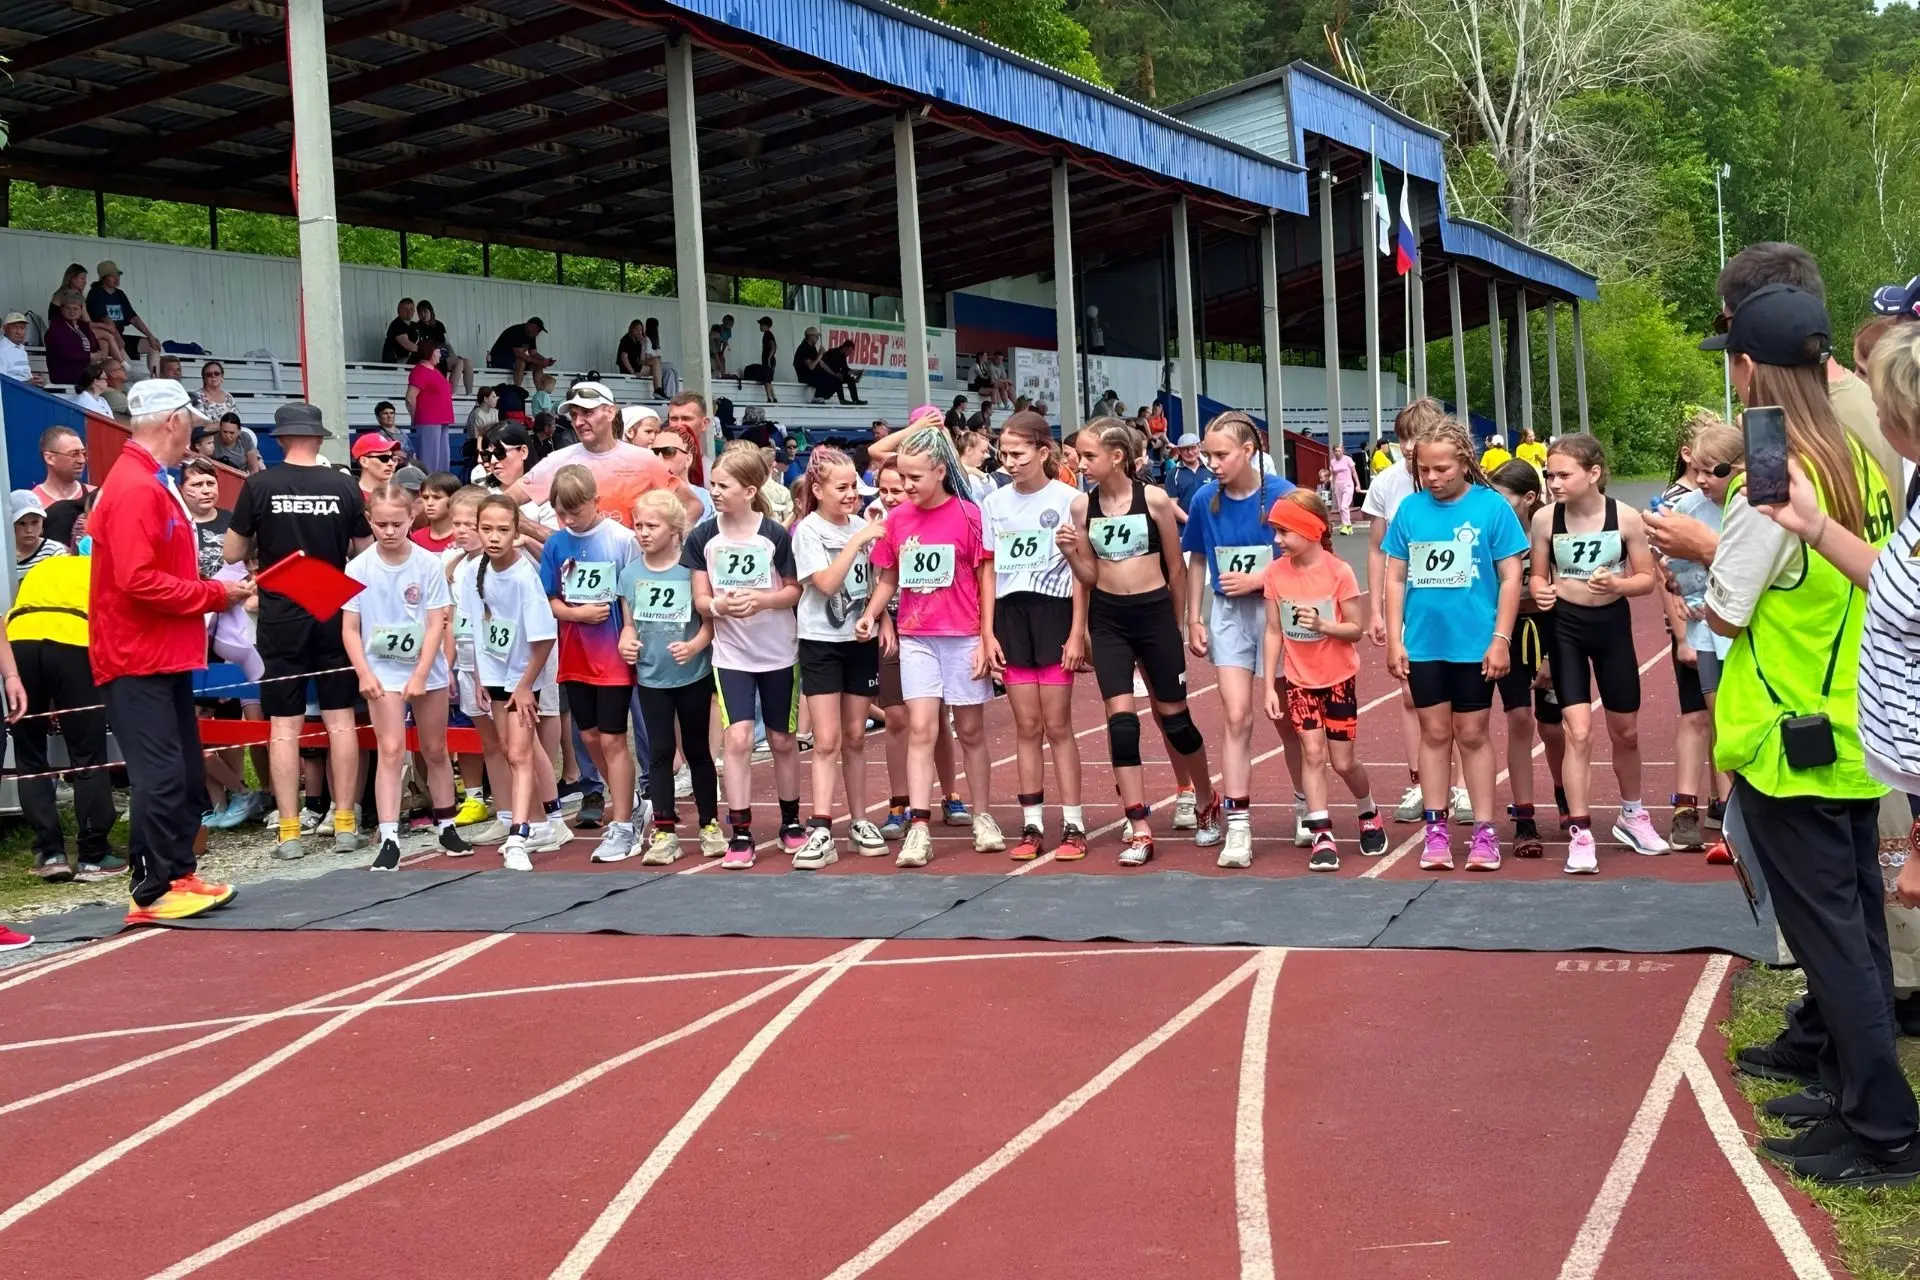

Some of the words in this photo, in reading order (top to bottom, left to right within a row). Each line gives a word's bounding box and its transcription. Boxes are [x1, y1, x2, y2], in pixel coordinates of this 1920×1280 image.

[271, 500, 340, 515] ЗВЕЗДА
[1104, 524, 1131, 545] 74
[1010, 536, 1038, 558] 65
[1572, 541, 1602, 563] 77
[728, 554, 756, 575] 73
[913, 551, 941, 573] 80
[1229, 554, 1257, 573] 67
[1426, 549, 1455, 572] 69
[577, 568, 601, 589] 75
[649, 587, 675, 608] 72
[1291, 605, 1319, 626] 7
[387, 633, 415, 652] 76
[489, 625, 510, 647] 83
